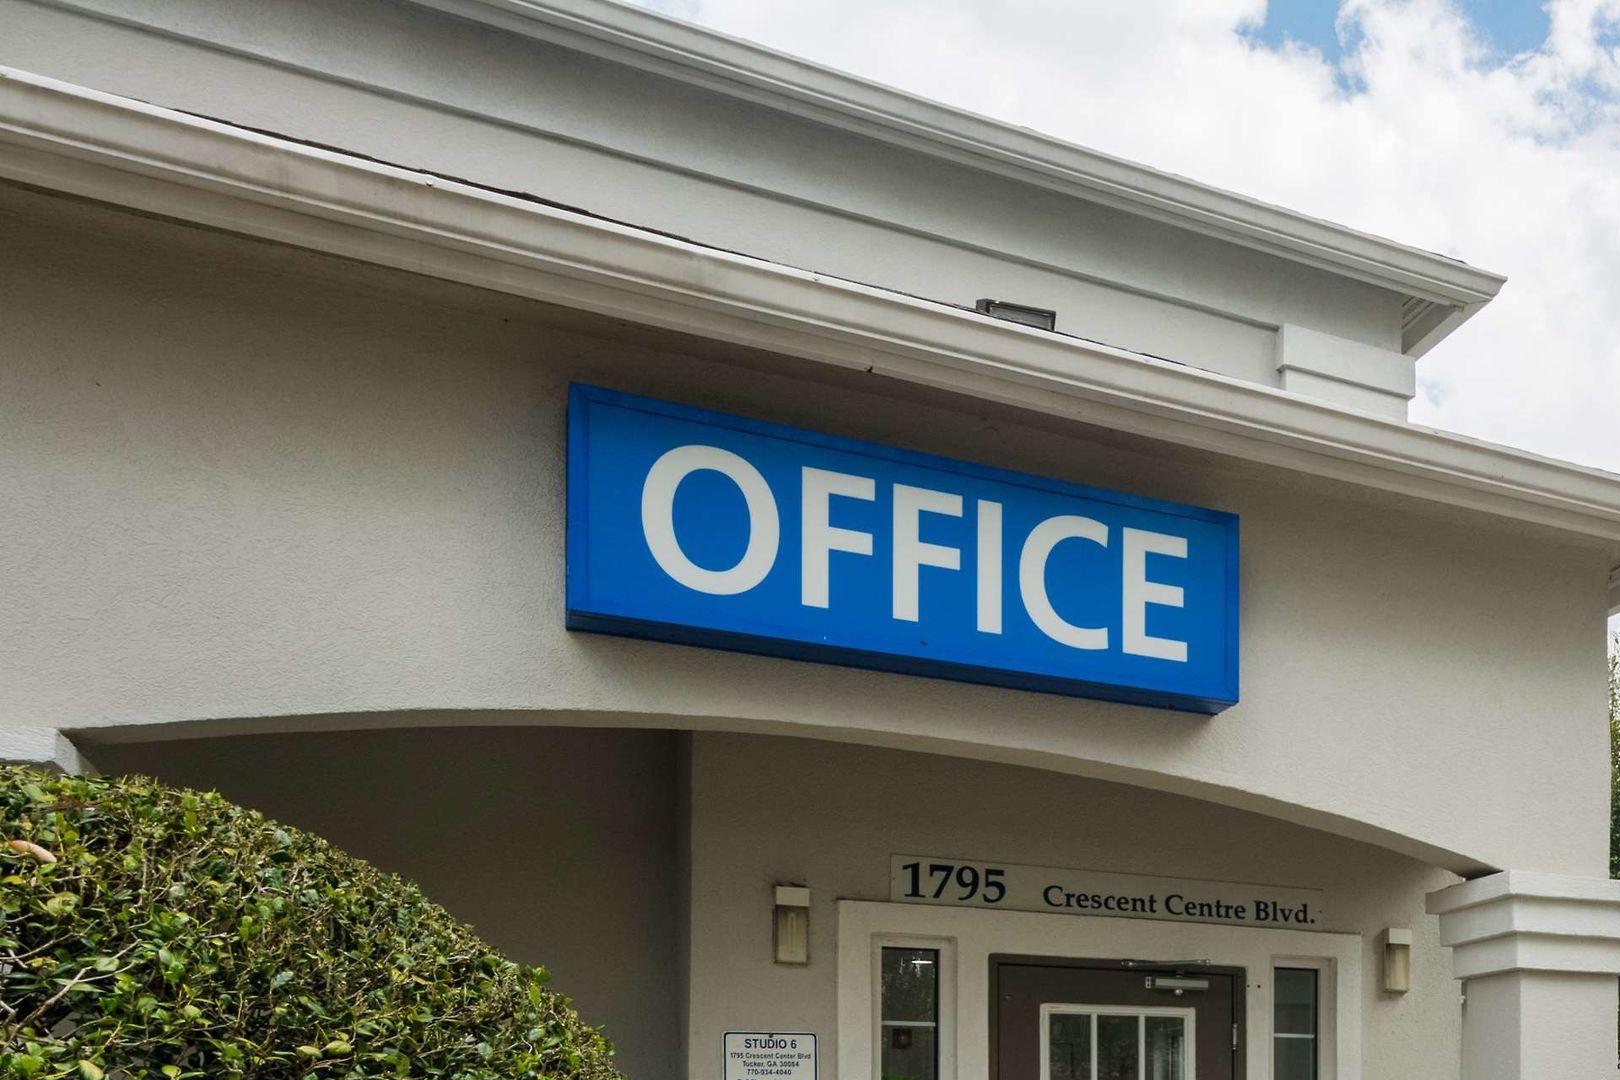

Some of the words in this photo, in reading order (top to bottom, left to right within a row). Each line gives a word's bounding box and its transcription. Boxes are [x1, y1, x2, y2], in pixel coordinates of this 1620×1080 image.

[641, 445, 1188, 662] OFFICE
[902, 862, 1007, 903] 1795
[1043, 885, 1157, 913] Crescent
[1165, 895, 1246, 920] Centre
[1254, 901, 1316, 924] Blvd.
[744, 1038, 787, 1049] STUDIO
[790, 1039, 797, 1049] 6
